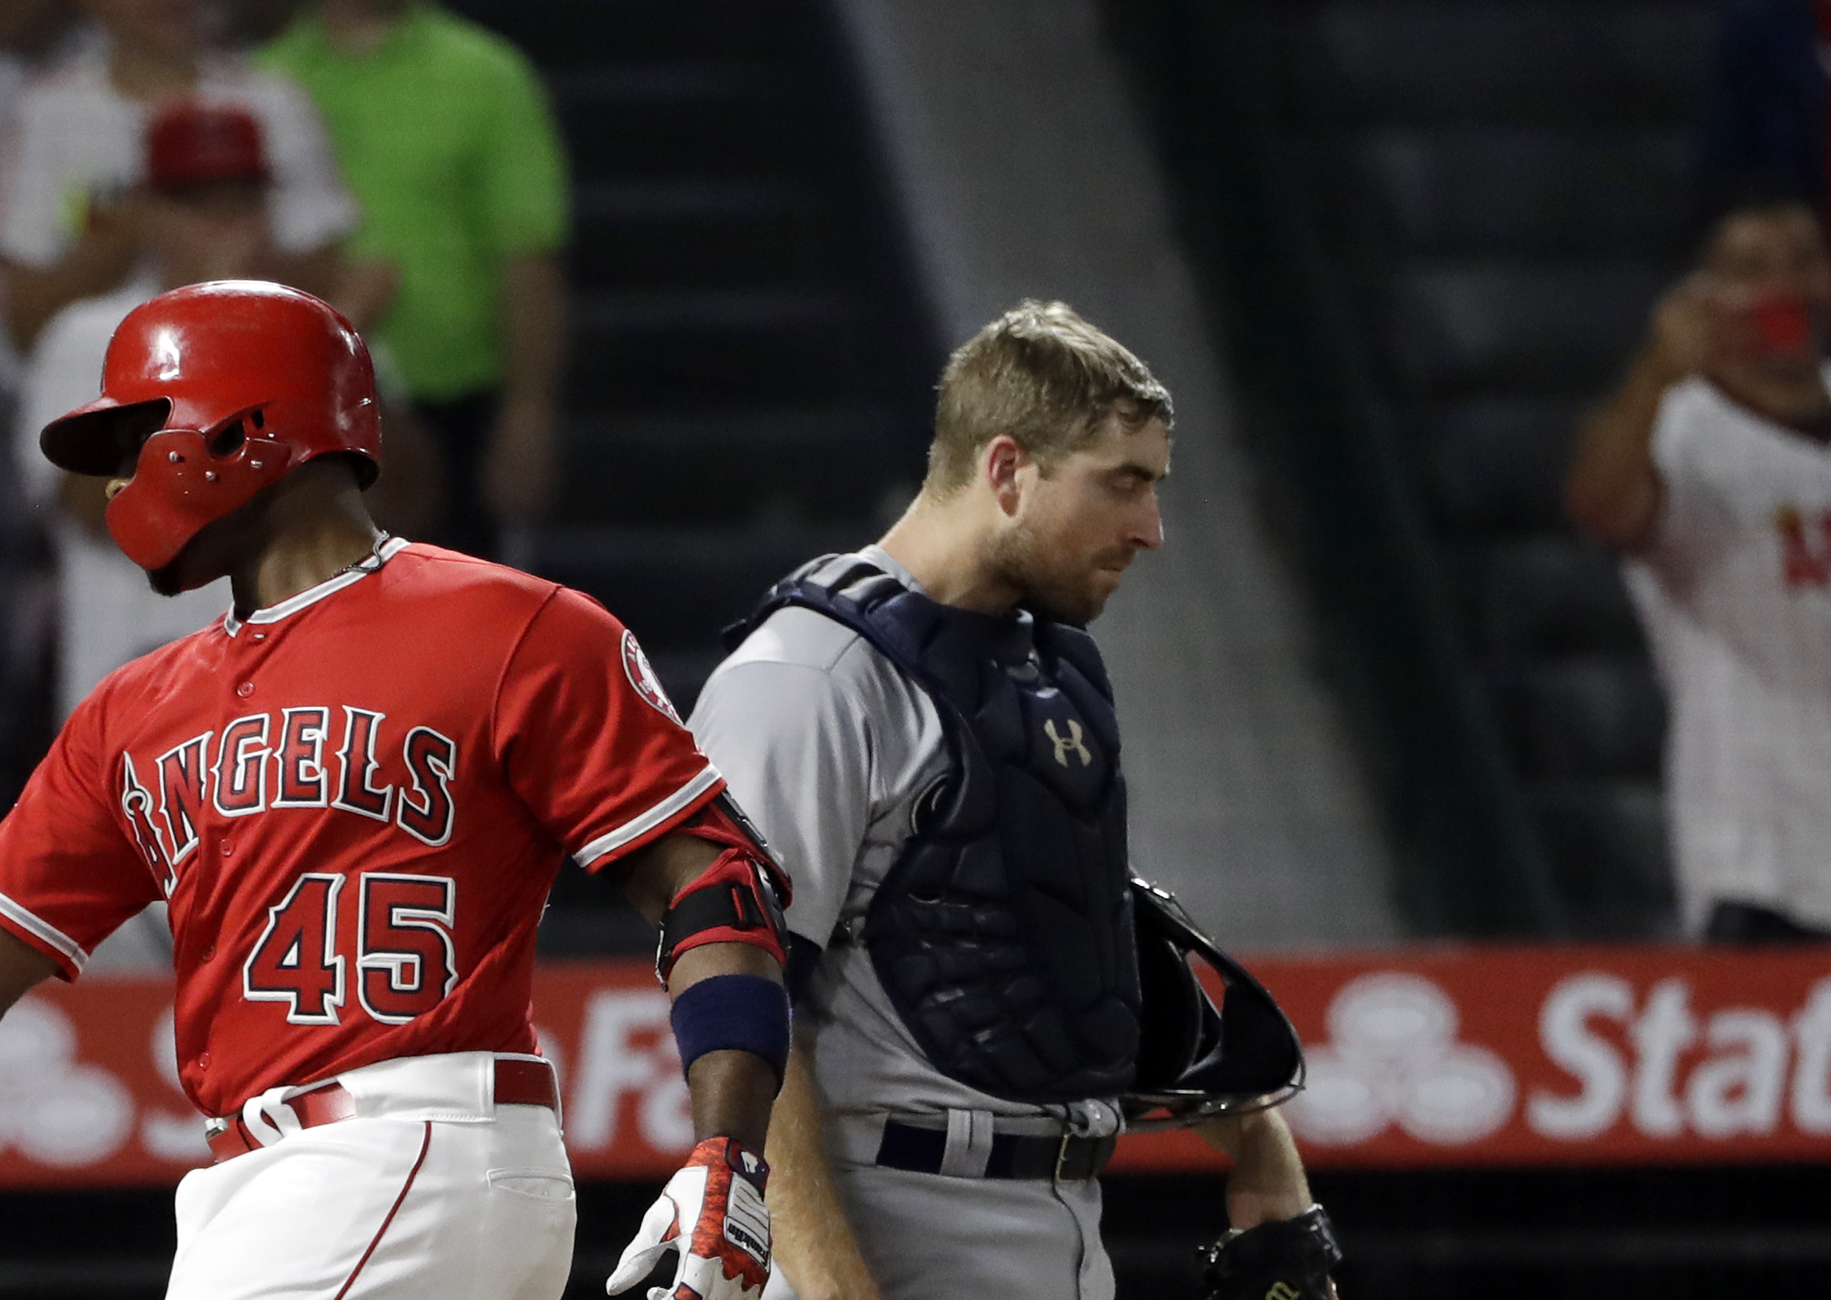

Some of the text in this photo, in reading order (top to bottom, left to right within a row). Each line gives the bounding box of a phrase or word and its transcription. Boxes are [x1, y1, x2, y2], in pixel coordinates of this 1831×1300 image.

[122, 704, 456, 899] ANGELS
[243, 871, 460, 1026] 45
[571, 988, 696, 1152] Fa
